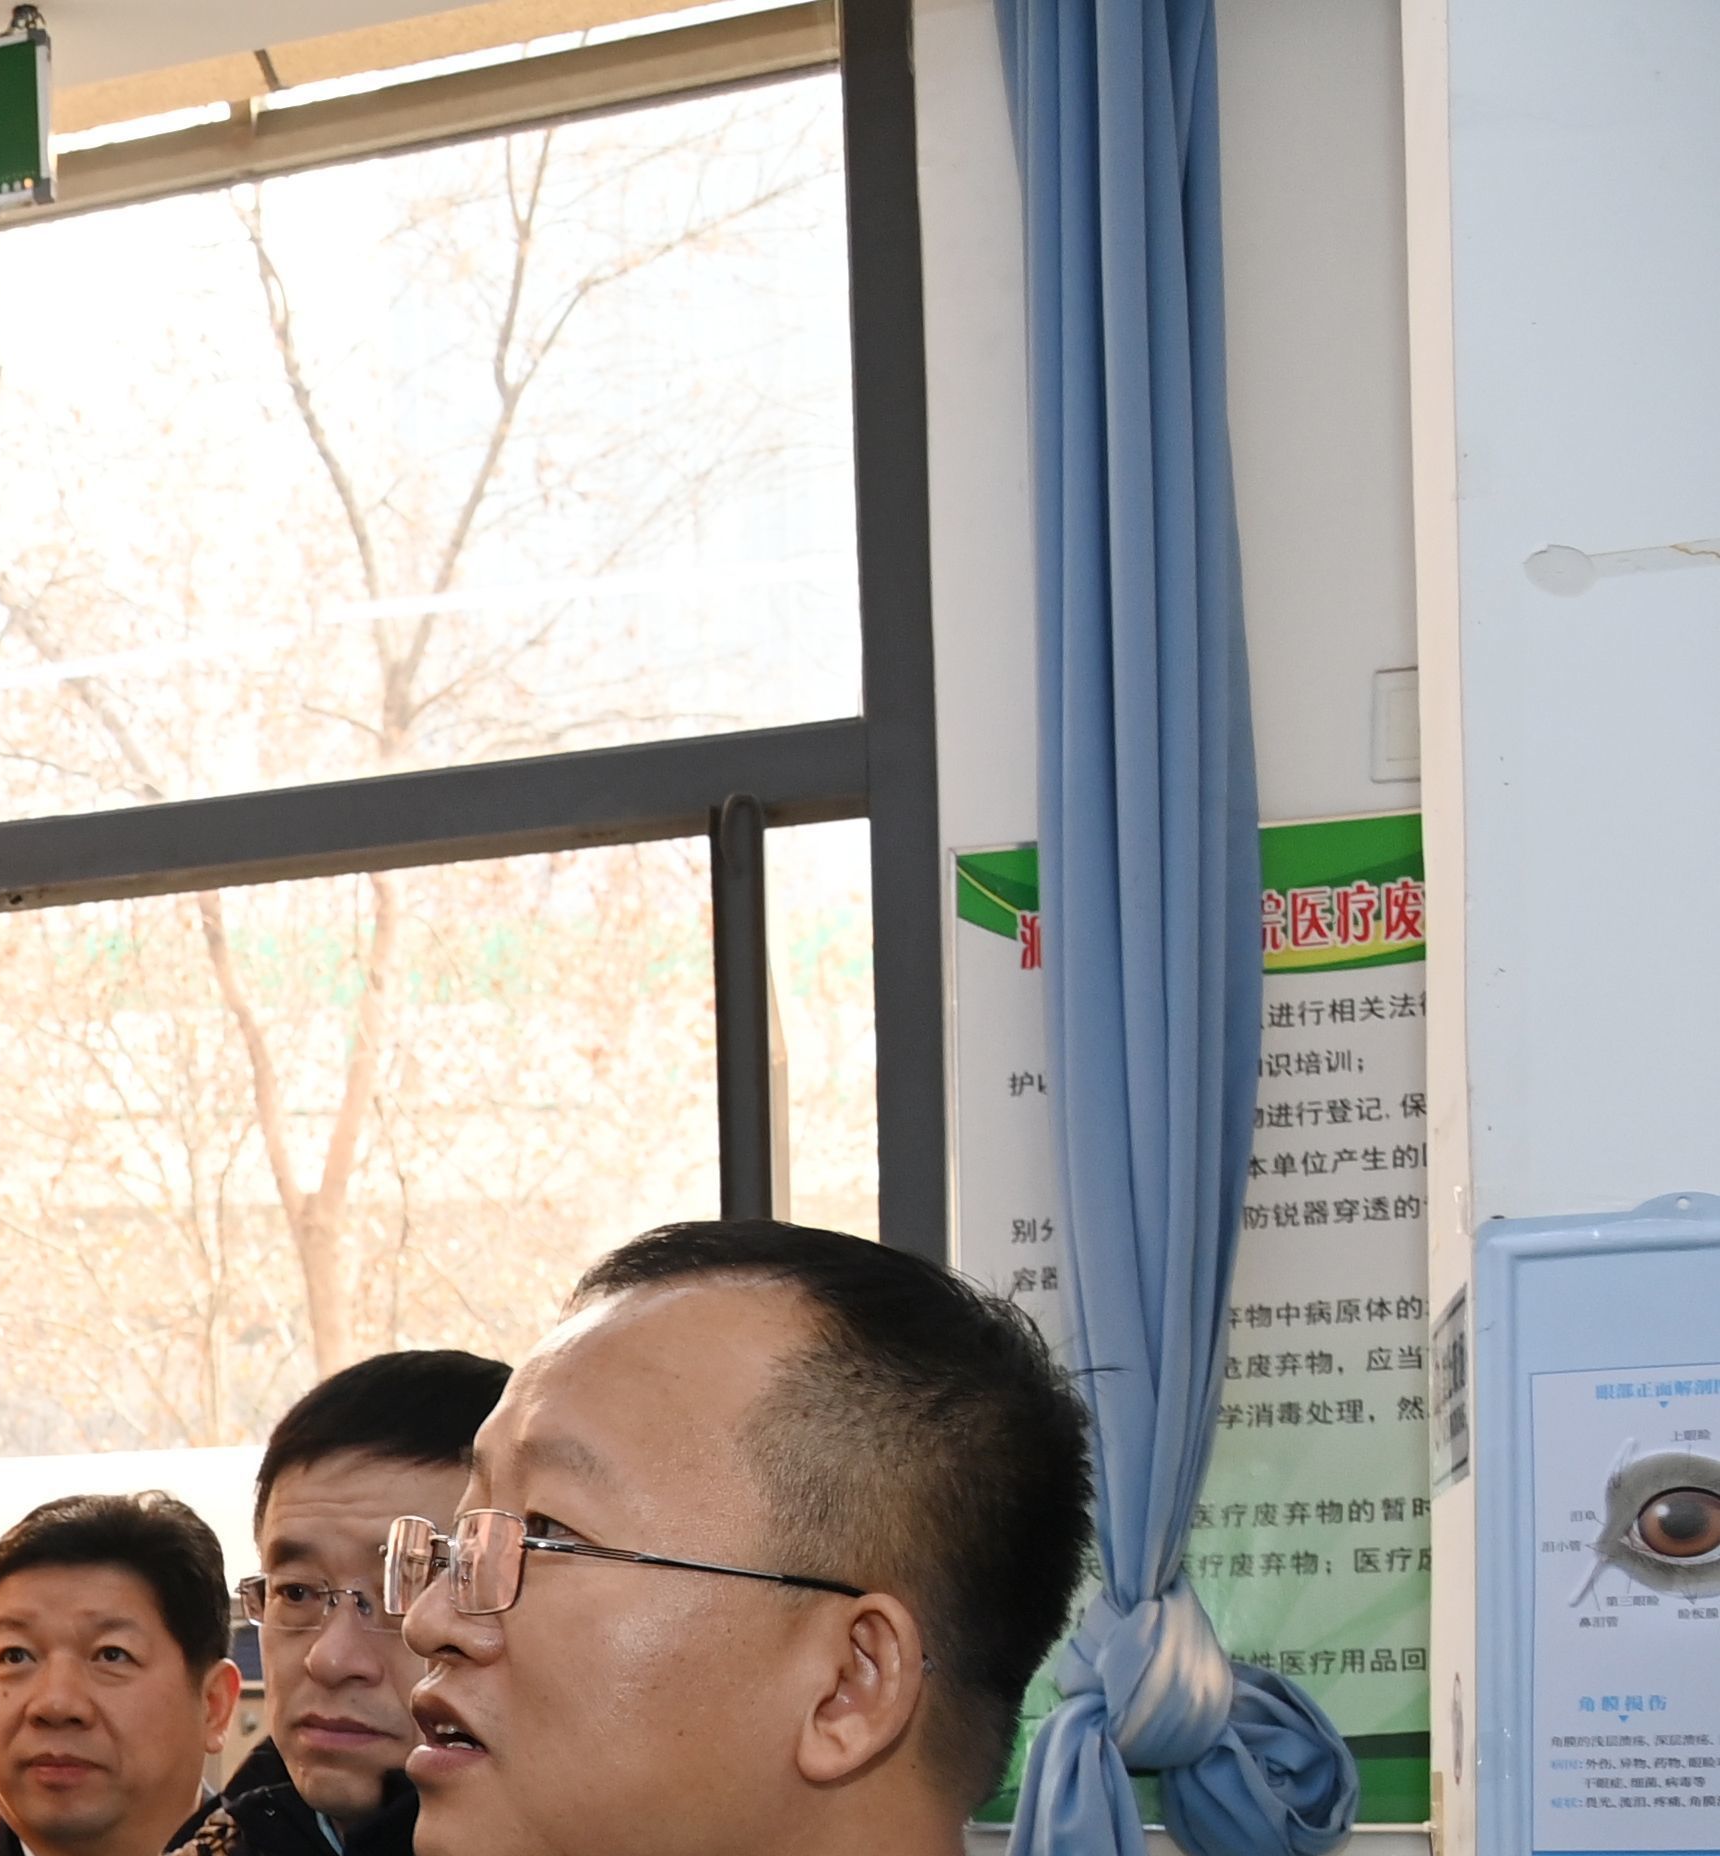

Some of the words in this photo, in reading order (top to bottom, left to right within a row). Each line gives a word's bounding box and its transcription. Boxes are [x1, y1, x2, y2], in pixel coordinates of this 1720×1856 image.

[1260, 991, 1426, 1030] 进行相关法
[1259, 1050, 1364, 1078] 识培训；
[1248, 1143, 1427, 1180] 本单位产生的
[1242, 1194, 1427, 1230] 防锐器穿透的
[1228, 1296, 1429, 1329] 物中病原体的
[1224, 1346, 1429, 1380] 危废弃物，应当
[1595, 1379, 1720, 1400] 眼部正面解剖
[1218, 1396, 1429, 1430] 学消毒处理，然
[1231, 1648, 1427, 1676] 性医疗用品回
